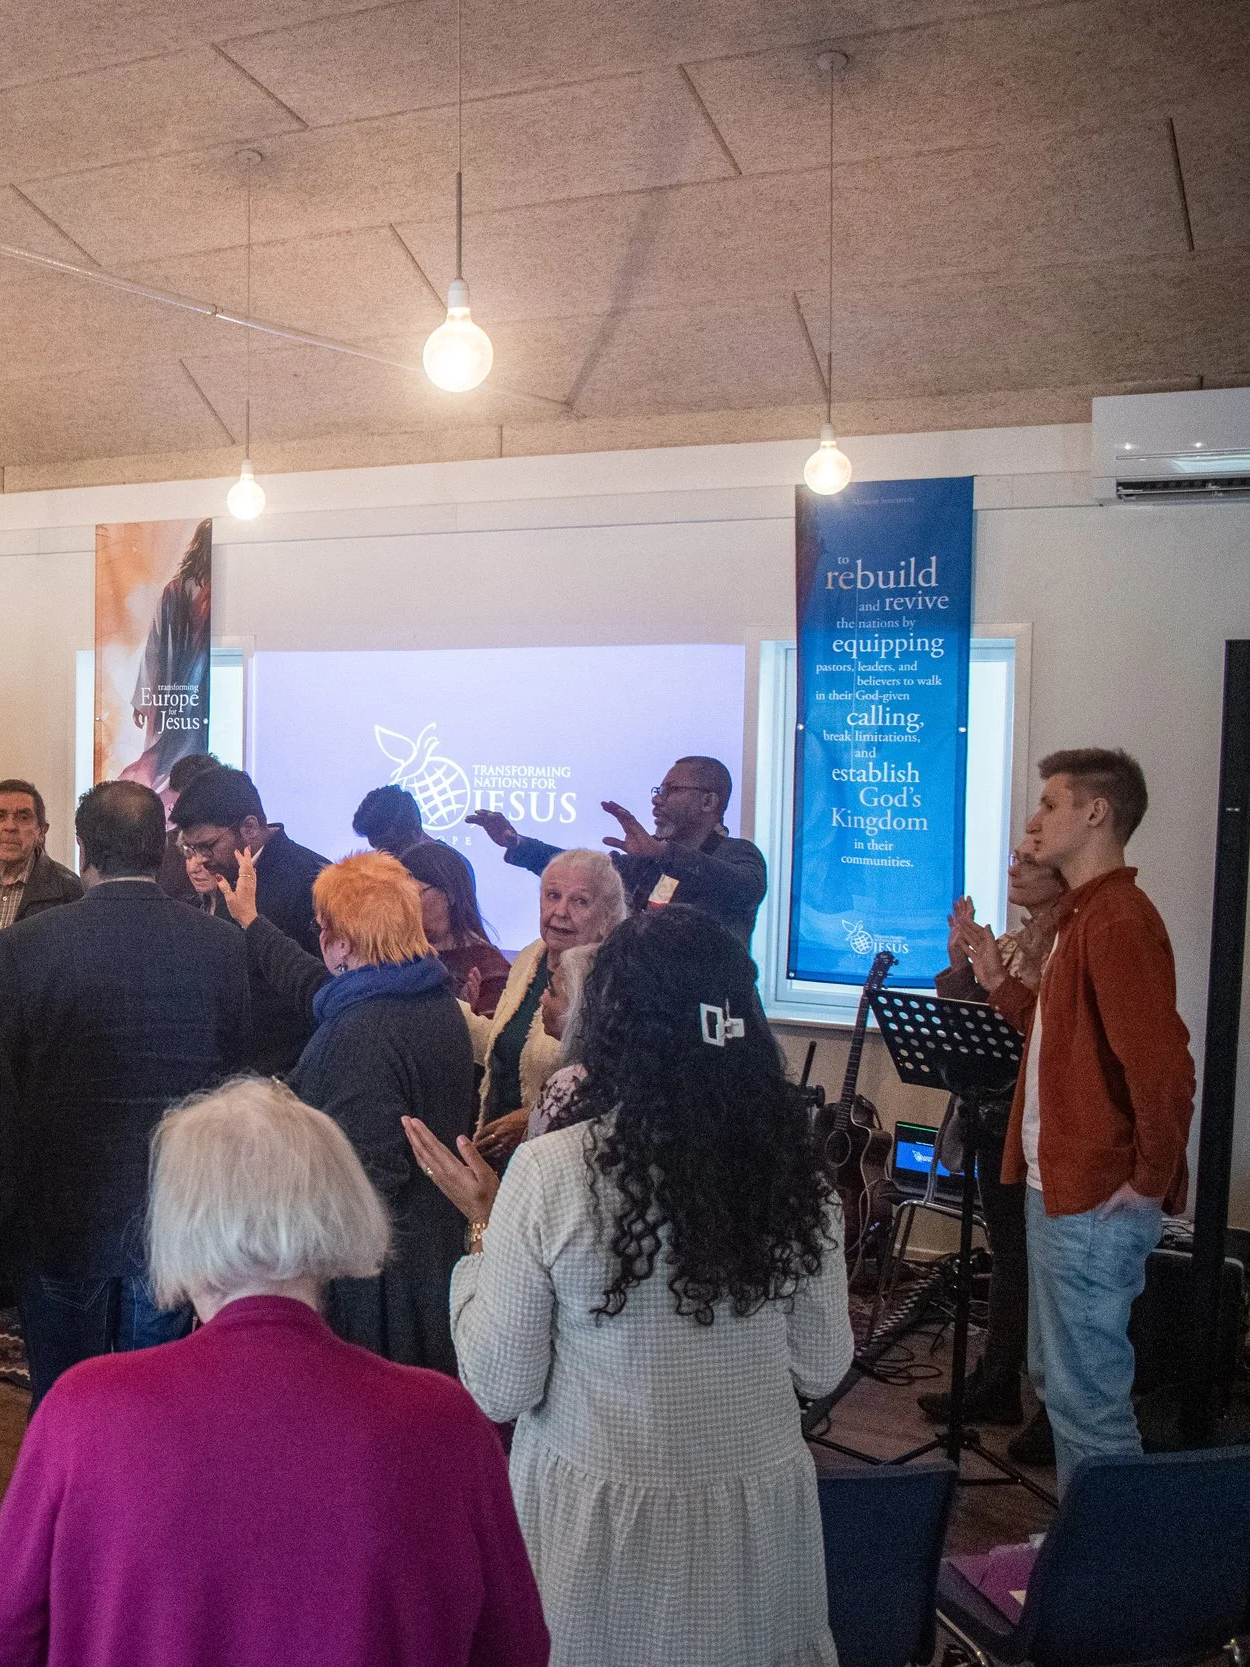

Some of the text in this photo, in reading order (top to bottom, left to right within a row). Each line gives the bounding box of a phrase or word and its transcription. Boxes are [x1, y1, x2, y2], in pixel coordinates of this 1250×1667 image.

[837, 556, 850, 565] to
[825, 555, 939, 590] rebuild
[858, 590, 949, 612] and revive
[836, 615, 916, 631] the nations by
[832, 632, 945, 659] equipping
[816, 660, 918, 675] pastors, leaders, and
[158, 682, 199, 693] transforming
[857, 675, 942, 686] believers to walk
[140, 687, 199, 713] Europe
[815, 690, 910, 703] in their God-given
[168, 707, 177, 715] for
[157, 710, 200, 734] Jesus
[846, 704, 925, 734] calling,
[823, 730, 921, 743] break limitations,
[854, 747, 877, 758] and
[472, 765, 571, 778] TRANSFORMING
[832, 761, 921, 783] establish
[473, 776, 557, 790] NATIONS FOR
[859, 786, 922, 807] God's
[470, 789, 578, 828] JESUS
[831, 807, 929, 837] Kingdom
[854, 838, 894, 851] in their
[840, 855, 914, 867] communities.
